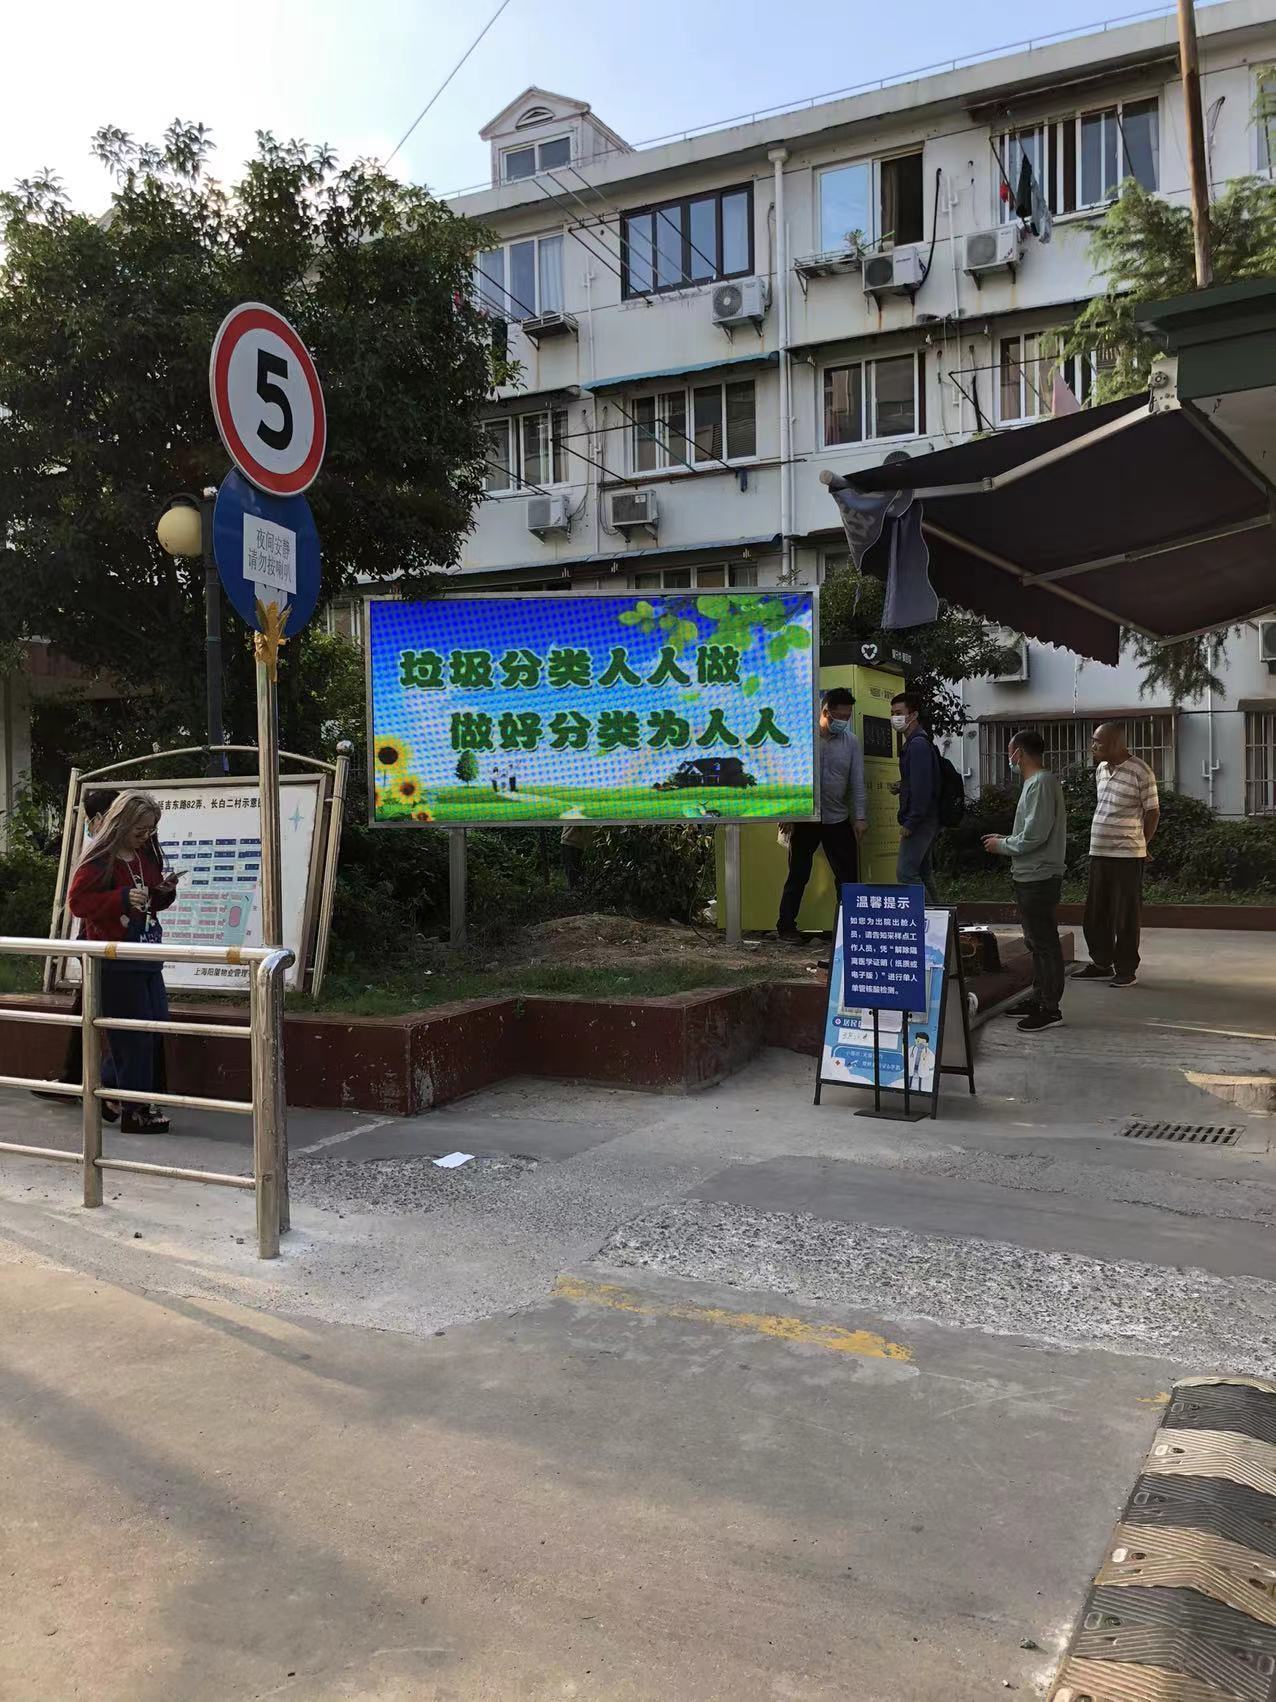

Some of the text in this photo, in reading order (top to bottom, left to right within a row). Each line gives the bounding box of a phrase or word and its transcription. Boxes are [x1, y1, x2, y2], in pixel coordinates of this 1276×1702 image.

[256, 348, 293, 450] 5
[257, 528, 290, 560] 夜间安静
[248, 548, 291, 583] 请勿按喇叭
[400, 645, 742, 690] 垃圾分类人人做
[449, 707, 792, 752] 做好分类为人人
[856, 895, 910, 909] 温馨提示
[850, 917, 917, 927] 如您为出院出舱人
[194, 967, 250, 978] 上海阳物业管理
